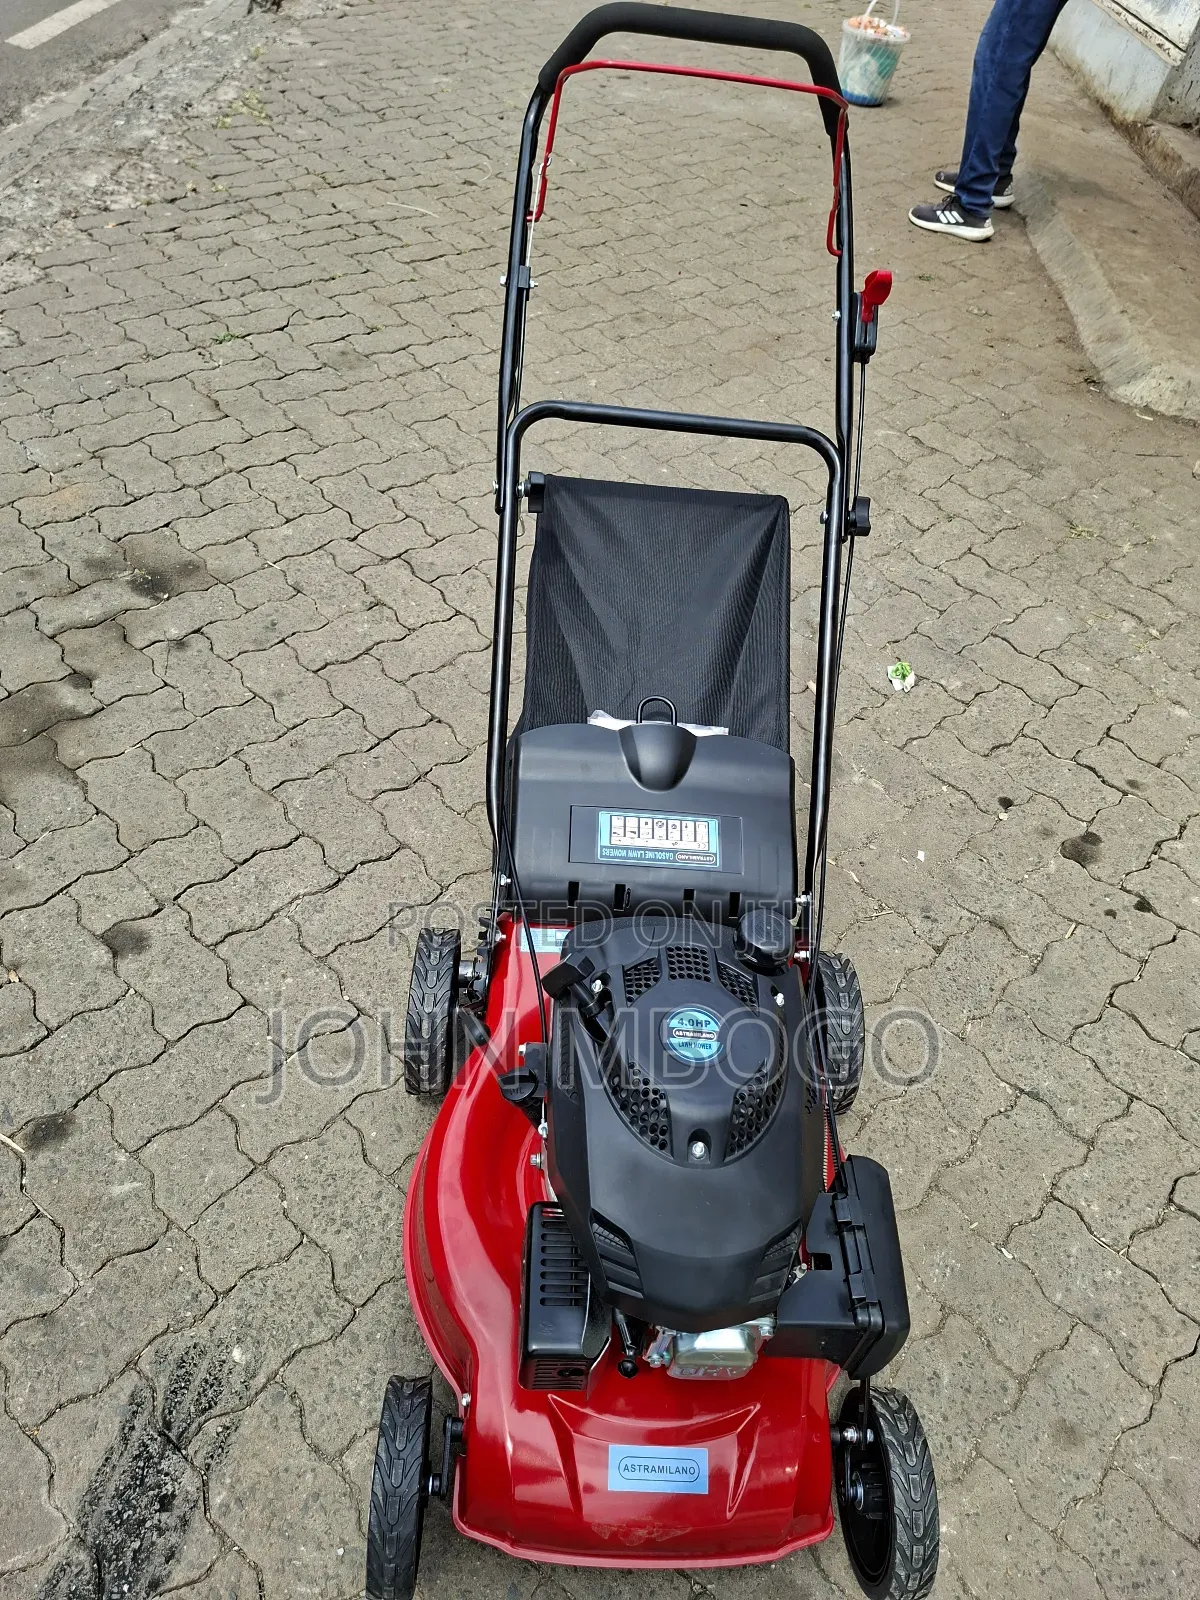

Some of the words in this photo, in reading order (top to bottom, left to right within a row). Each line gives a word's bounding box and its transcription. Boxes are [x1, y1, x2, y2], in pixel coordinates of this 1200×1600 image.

[602, 848, 626, 857] MOWERS
[628, 849, 644, 858] LAWN
[646, 850, 674, 860] GASOLINE
[677, 1018, 711, 1028] 4.0HP
[694, 1042, 712, 1050] MOWER
[623, 1463, 696, 1476] ASTRAMILANO
